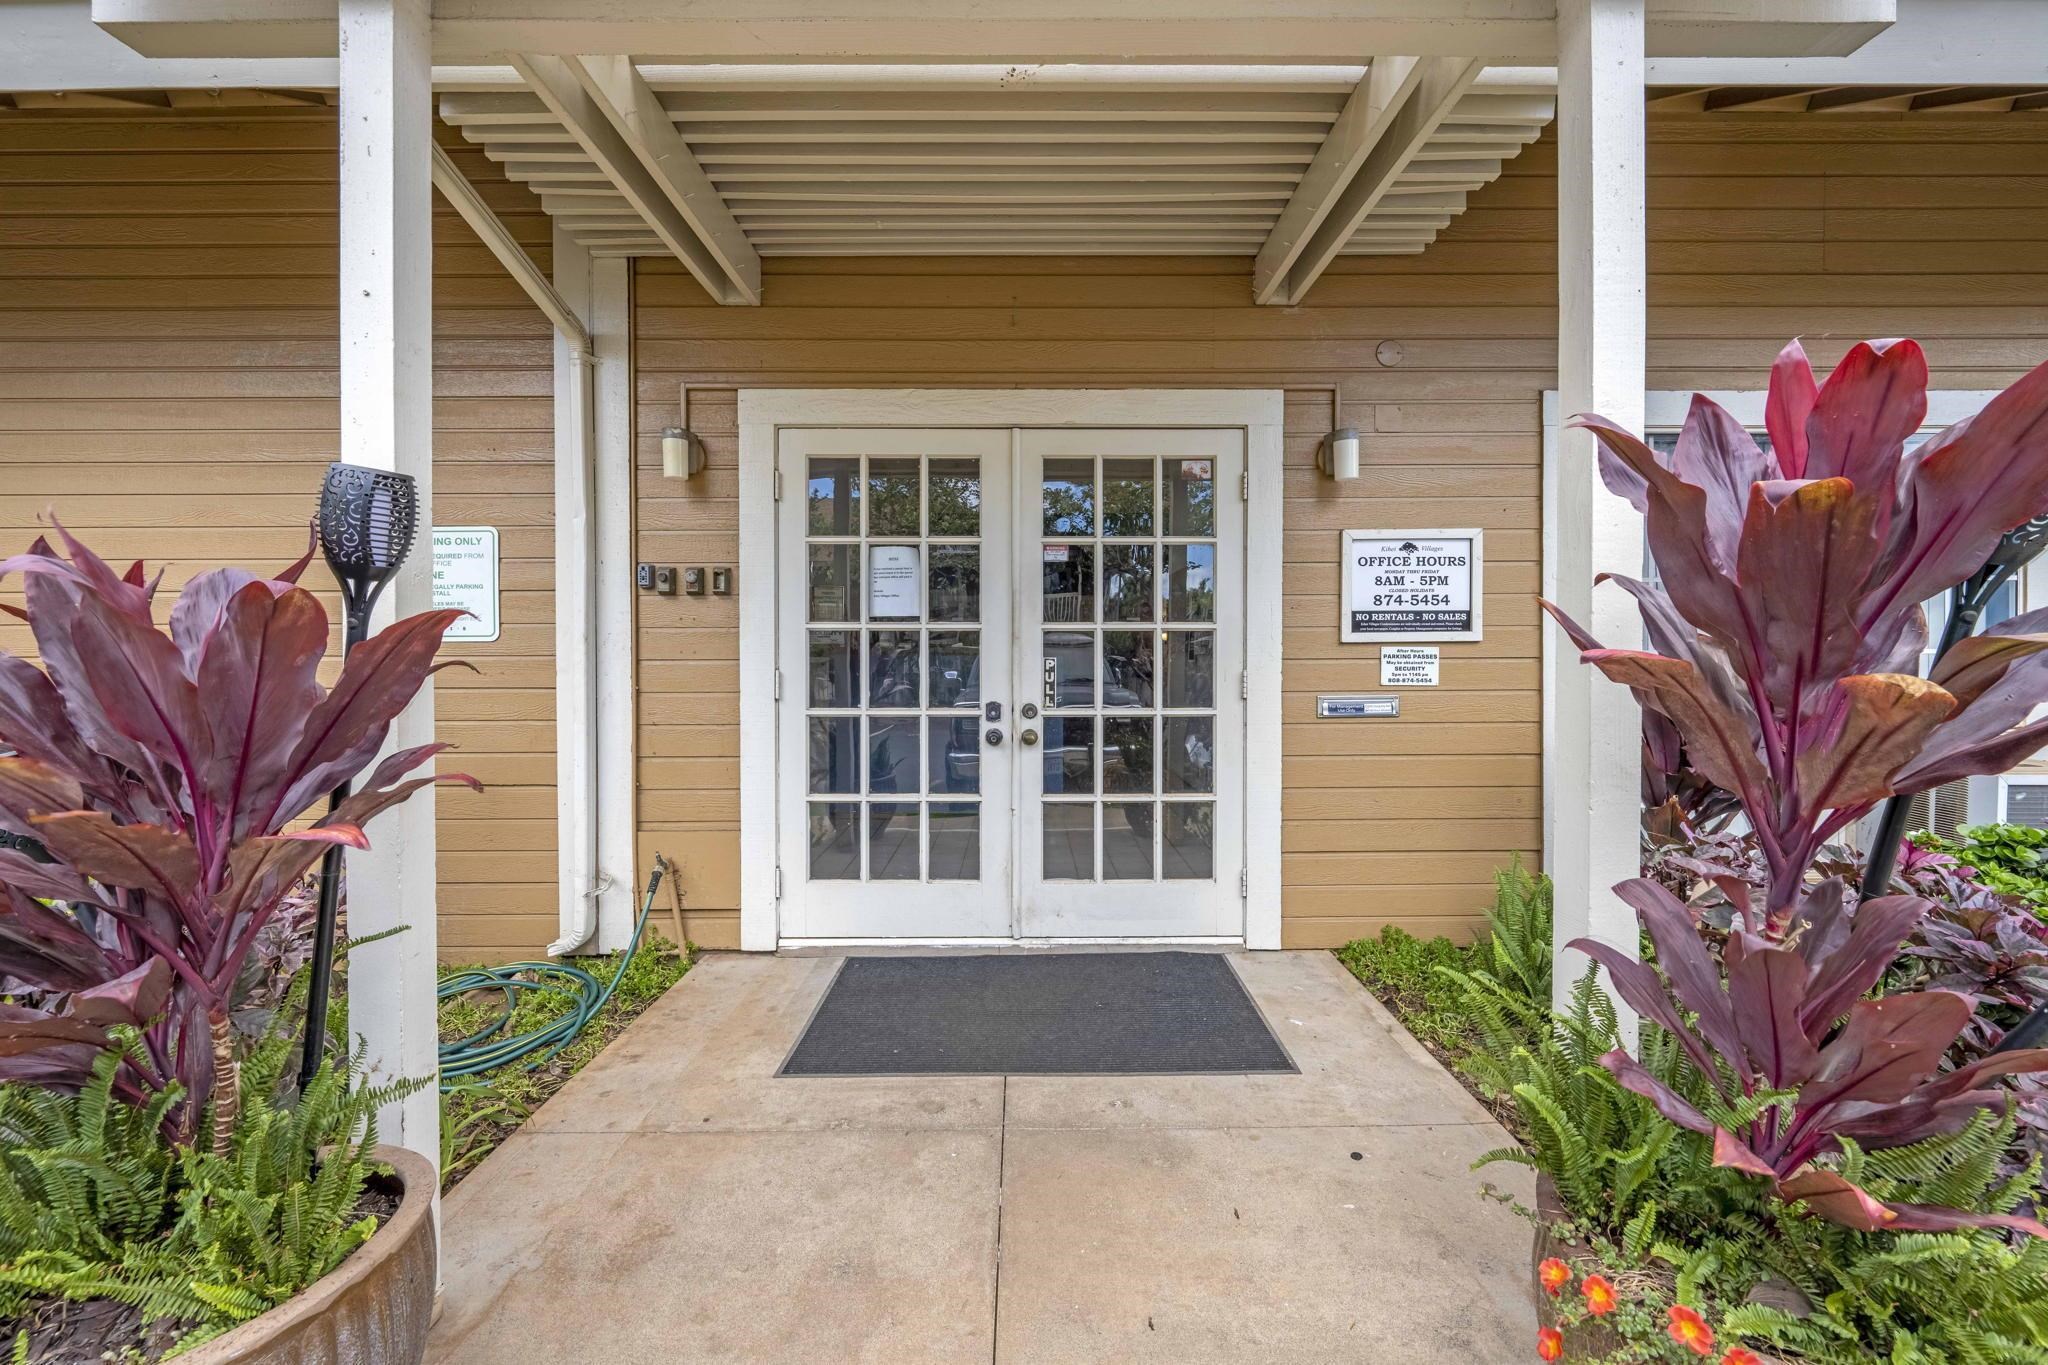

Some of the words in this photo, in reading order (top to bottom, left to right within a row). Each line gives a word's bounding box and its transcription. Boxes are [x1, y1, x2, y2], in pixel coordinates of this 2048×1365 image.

[433, 537, 452, 546] ING
[454, 537, 482, 546] ONLY
[1358, 556, 1411, 567] OFFICE
[1415, 556, 1466, 567] HOURS
[433, 571, 445, 579] NE
[1374, 576, 1405, 586] 8AM
[1419, 576, 1449, 586] 5PM
[1373, 594, 1451, 606] 874-5454
[1355, 613, 1370, 621] NO
[1371, 613, 1415, 621] RENTALS
[1422, 613, 1436, 621] NO
[1437, 613, 1467, 621] SALES
[1045, 659, 1055, 707] PULL
